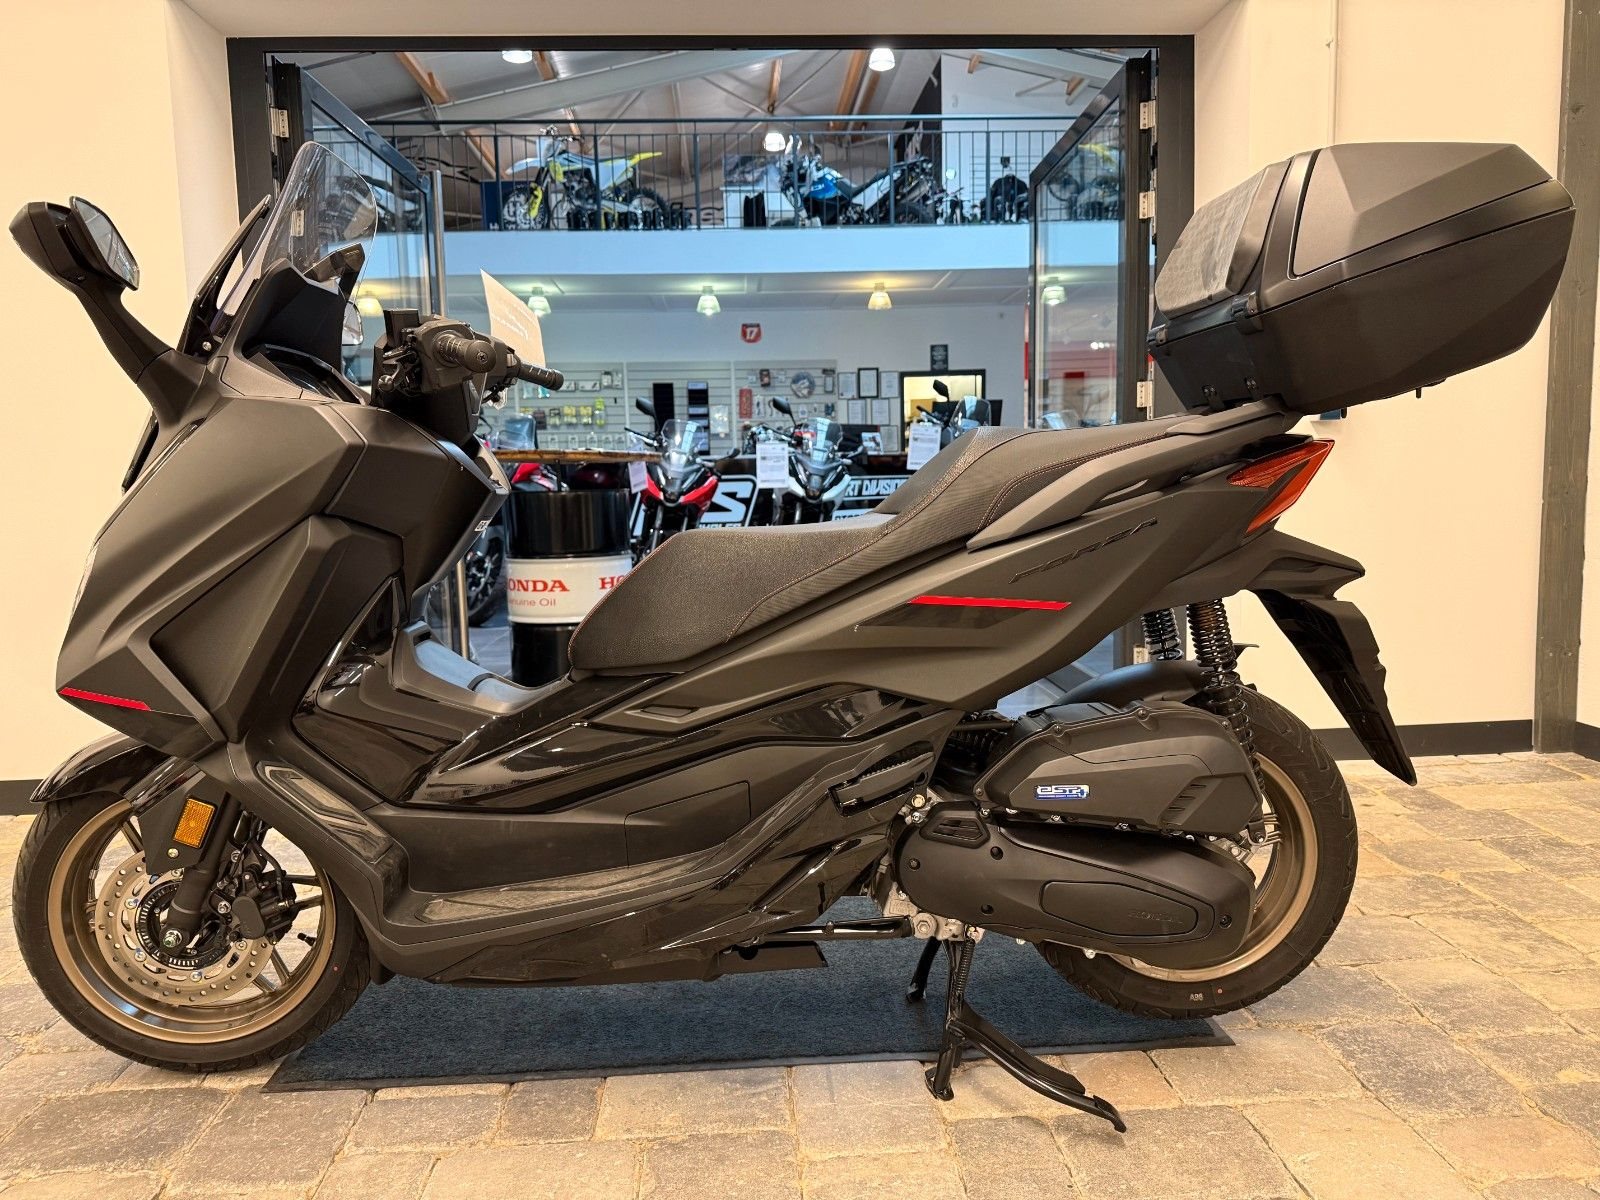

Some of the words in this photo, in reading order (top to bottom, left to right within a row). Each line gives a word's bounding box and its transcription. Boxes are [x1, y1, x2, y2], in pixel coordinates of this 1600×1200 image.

[862, 479, 907, 496] DIVISIO
[508, 578, 570, 593] ONDA
[539, 598, 556, 607] Oil
